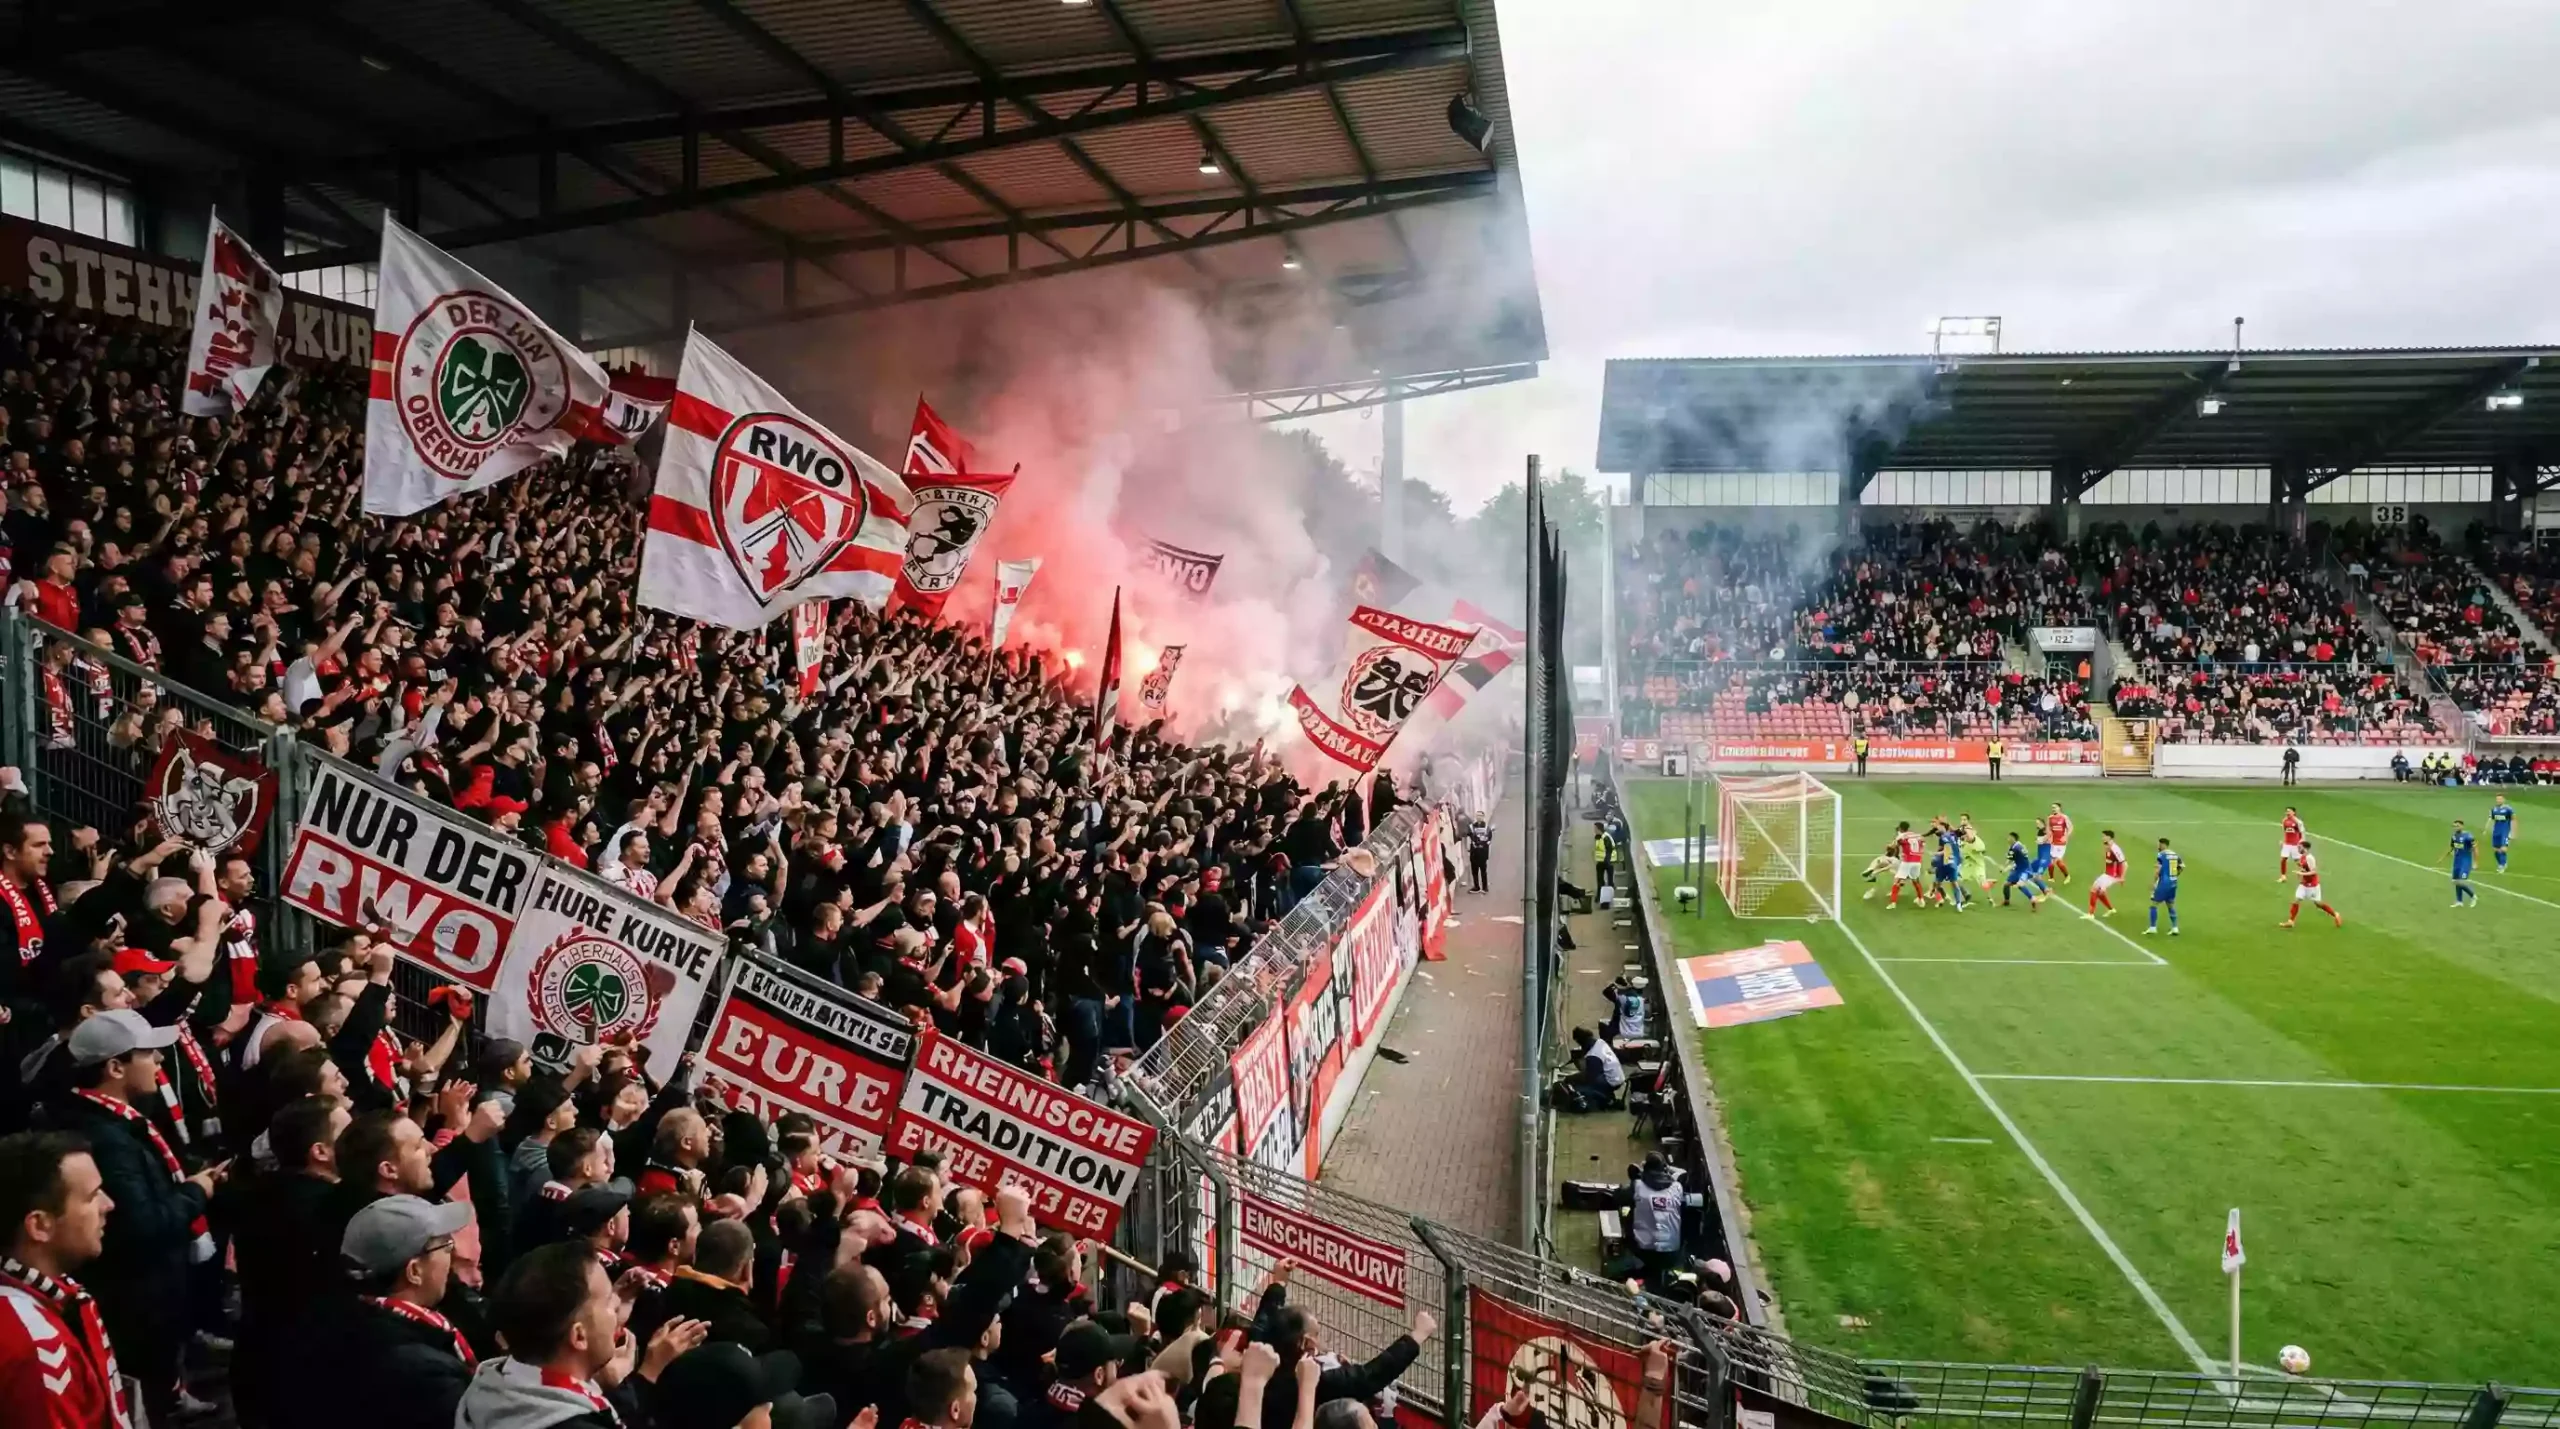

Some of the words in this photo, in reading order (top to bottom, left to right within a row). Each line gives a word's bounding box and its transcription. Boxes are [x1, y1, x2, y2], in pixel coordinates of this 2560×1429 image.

[447, 301, 501, 328] DER
[749, 425, 844, 488] RWO
[309, 773, 418, 868] NUR
[424, 826, 527, 914] DER
[289, 839, 499, 974] RWO
[618, 914, 713, 982] KURVE
[716, 1015, 890, 1121] EURE
[929, 1041, 1143, 1155] RHEINISCHE
[921, 1082, 1126, 1197] TRADITION
